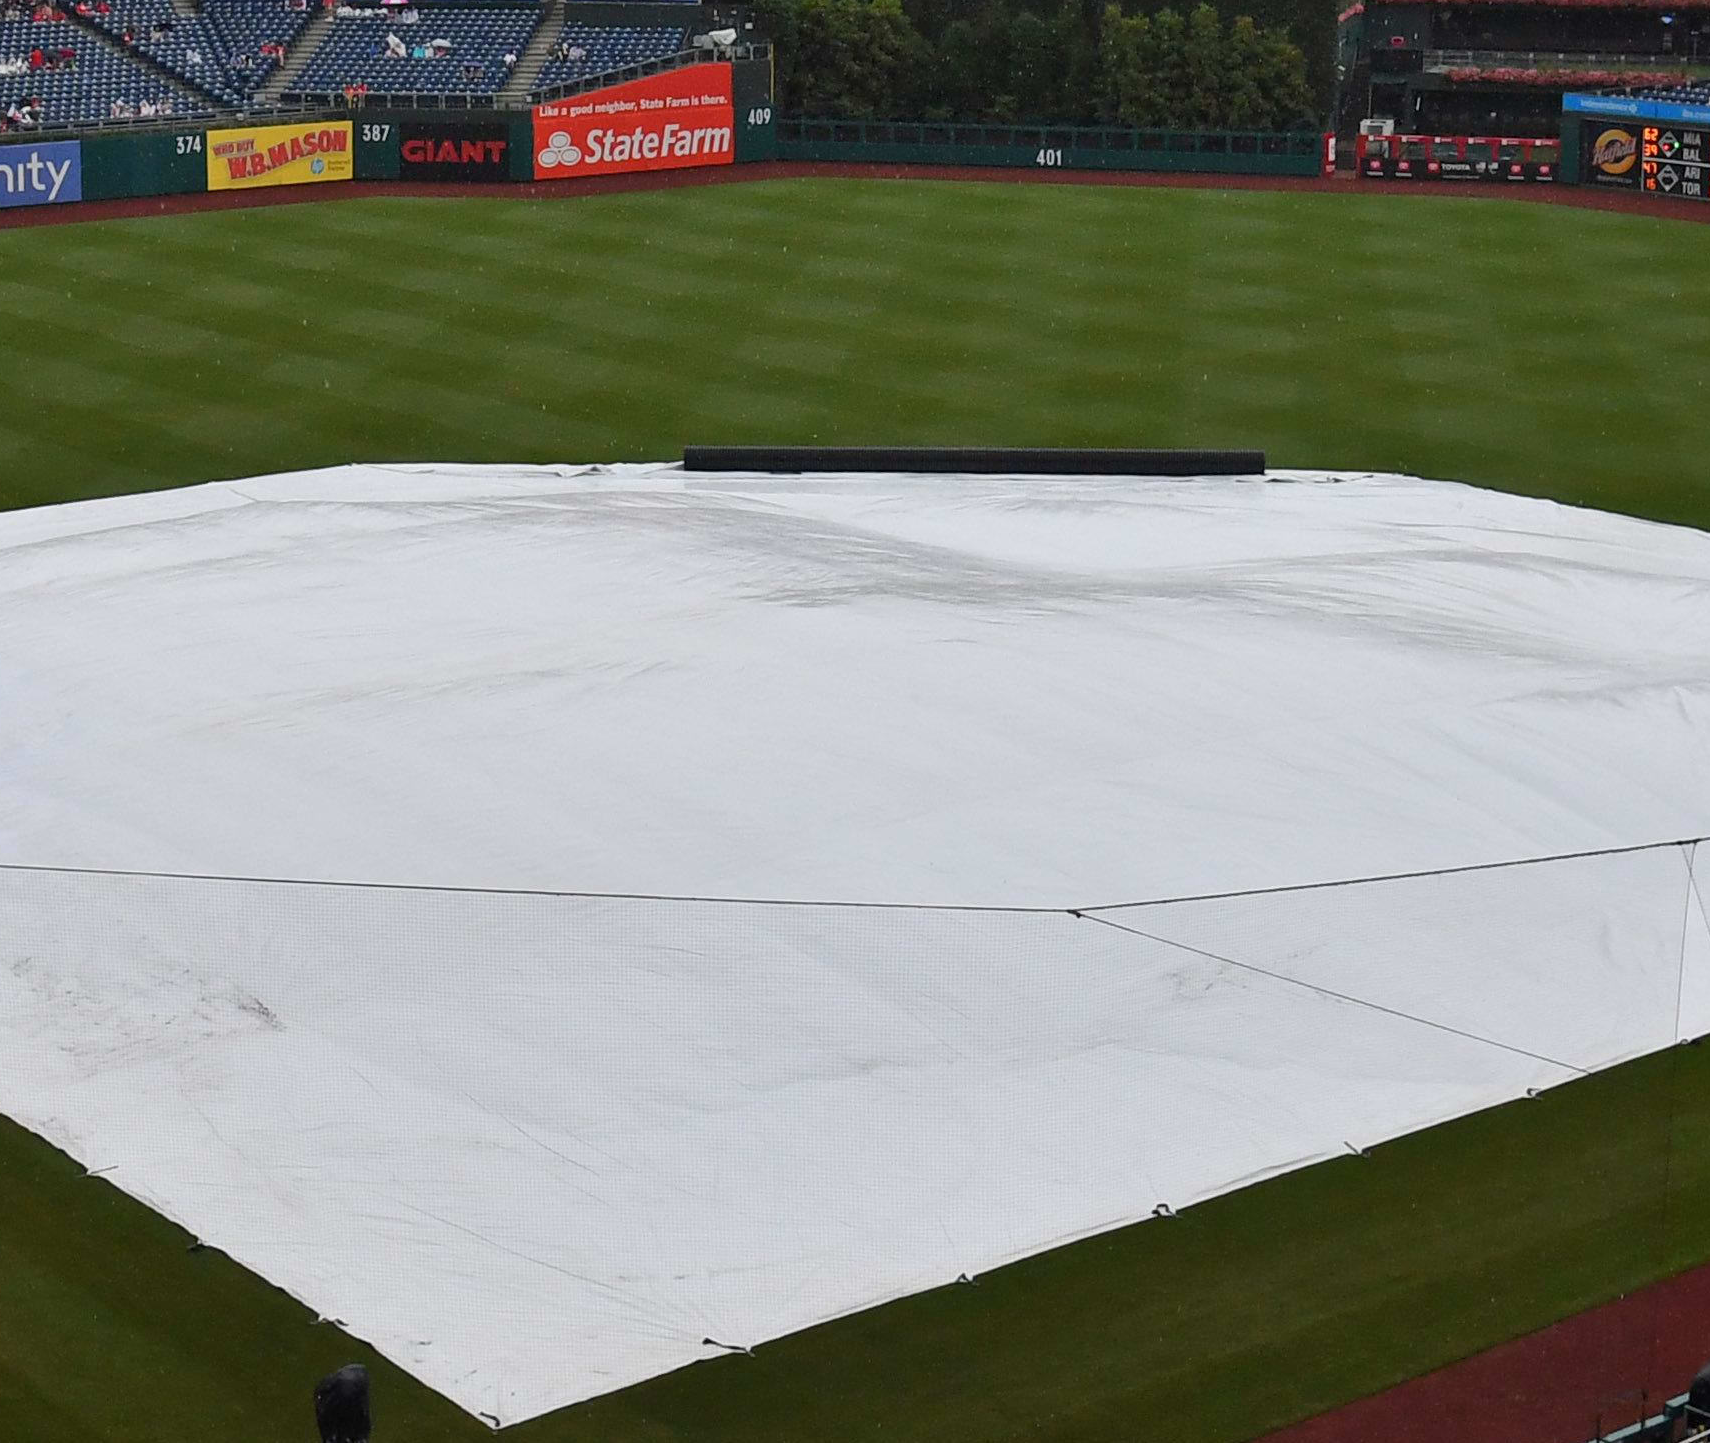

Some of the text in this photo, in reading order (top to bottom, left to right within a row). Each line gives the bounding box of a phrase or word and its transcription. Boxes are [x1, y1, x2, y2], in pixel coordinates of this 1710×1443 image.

[539, 94, 728, 118] Like a good neighbor, State Farm is there.
[748, 107, 771, 126] 409
[362, 123, 390, 142] 387
[1683, 133, 1701, 146] MIA
[176, 134, 202, 156] 374
[400, 139, 507, 164] GIANT
[1036, 149, 1063, 167] 401
[1682, 148, 1701, 162] BAL
[1684, 166, 1701, 180] ARI
[1681, 182, 1701, 196] TOR
